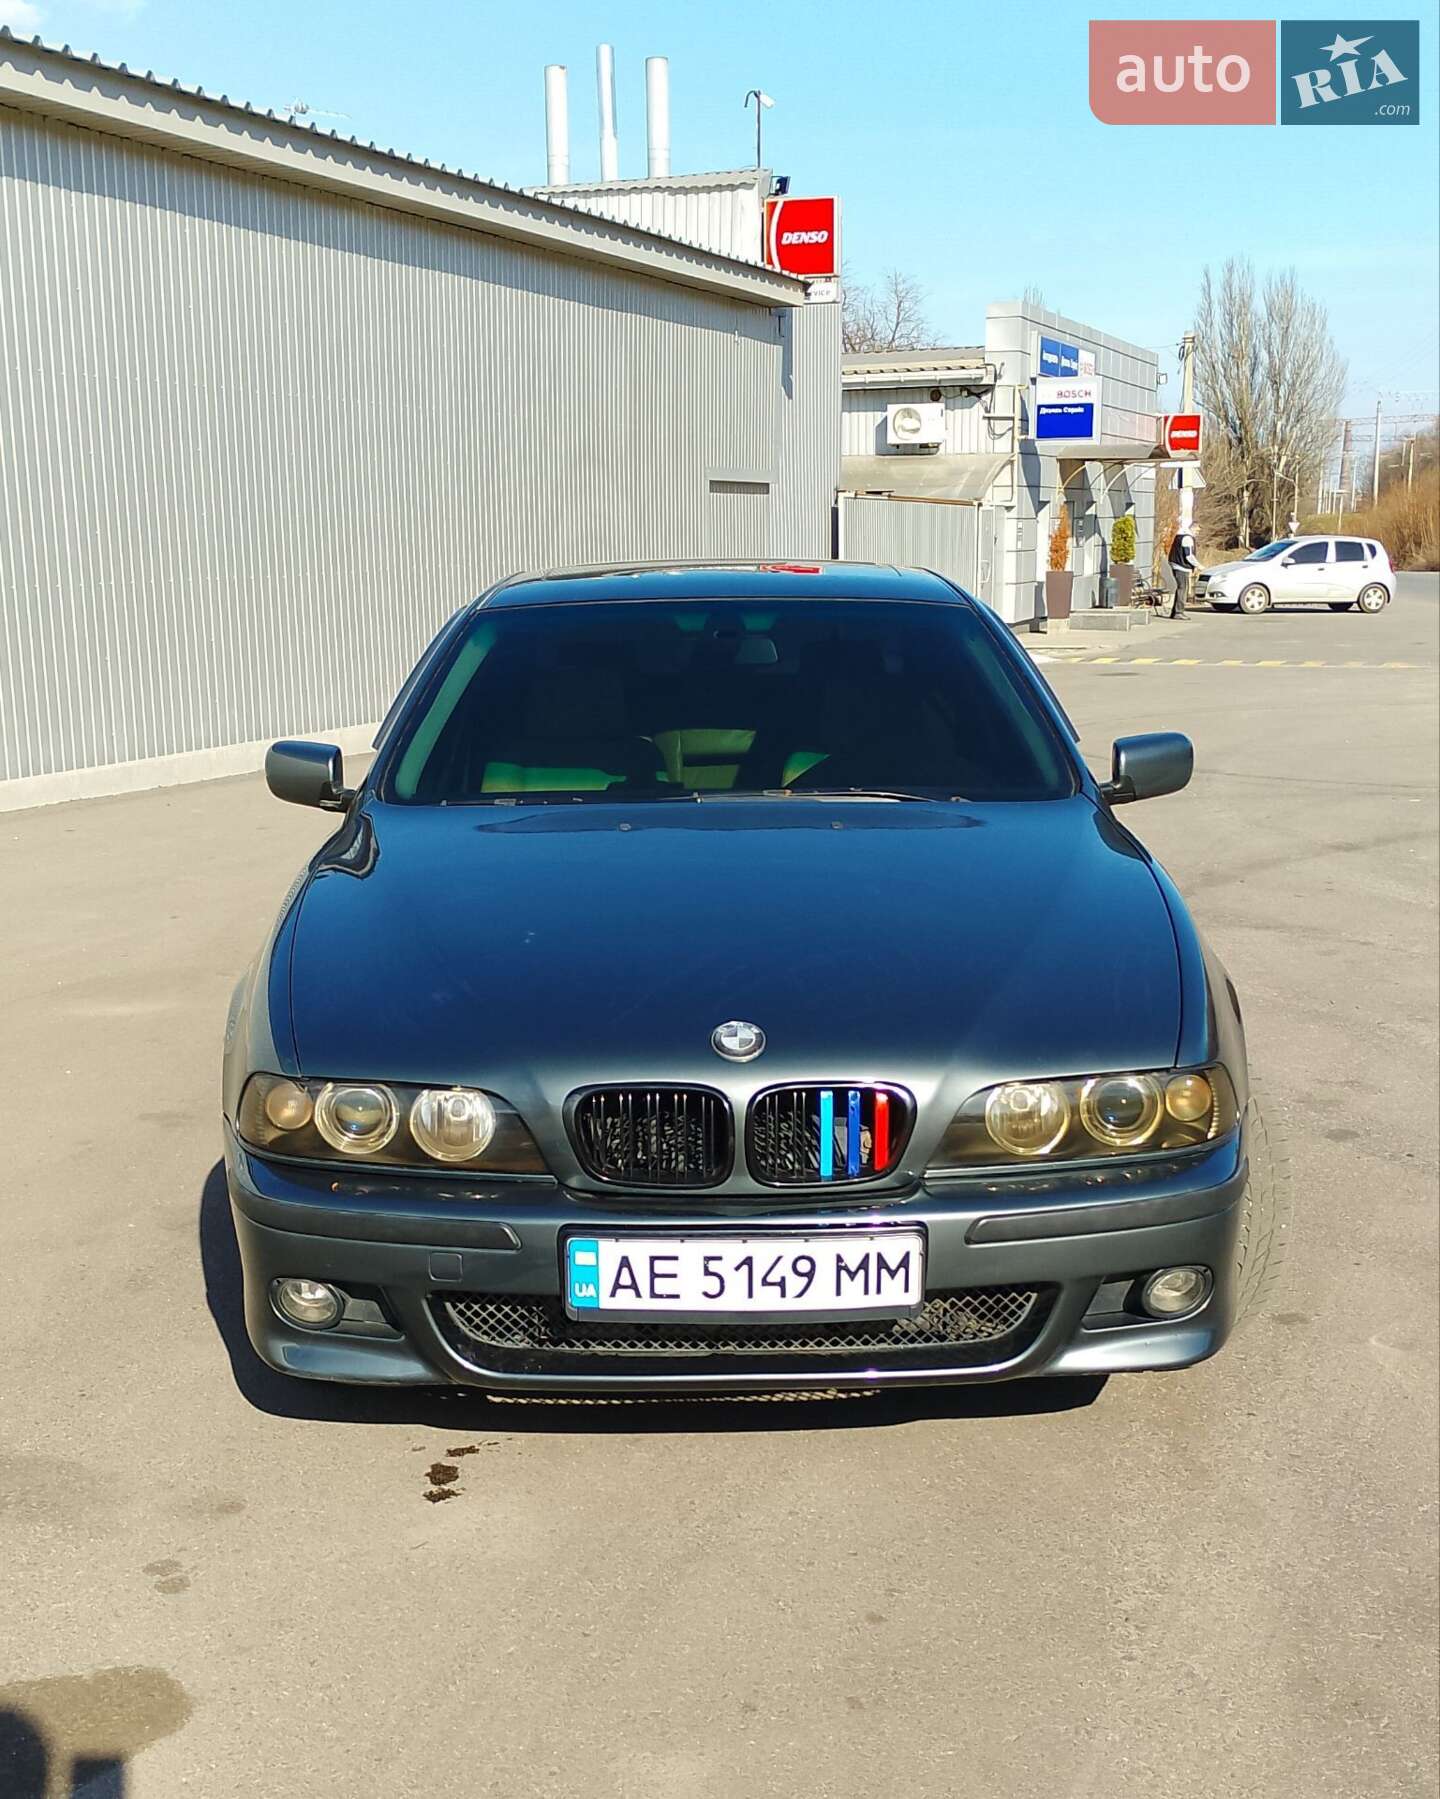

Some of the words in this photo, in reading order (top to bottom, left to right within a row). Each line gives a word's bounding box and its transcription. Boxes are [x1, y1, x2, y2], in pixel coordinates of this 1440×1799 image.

[781, 230, 829, 245] DENSO
[1056, 389, 1092, 399] BOSCH
[609, 1255, 681, 1299] AE
[702, 1255, 817, 1300] 5149
[835, 1251, 911, 1297] MM
[574, 1282, 597, 1298] UA
